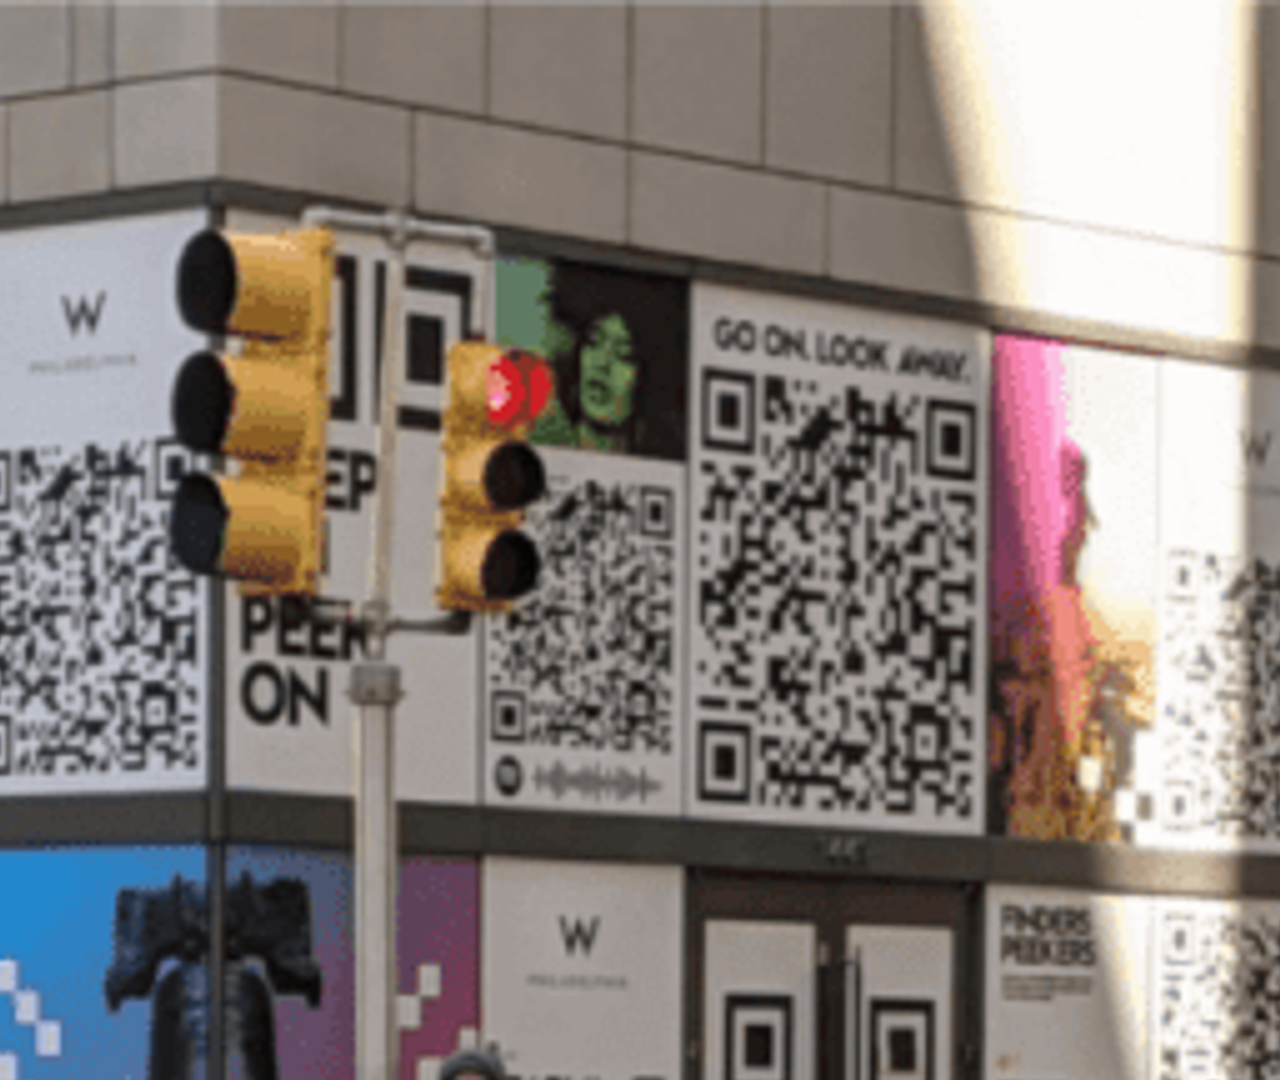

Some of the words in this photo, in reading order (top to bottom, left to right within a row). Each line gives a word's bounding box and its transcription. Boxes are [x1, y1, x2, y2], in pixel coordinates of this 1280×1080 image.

[60, 289, 106, 336] W
[714, 316, 756, 353] GO
[816, 331, 889, 371] LOOK
[240, 659, 330, 728] ON
[557, 914, 601, 960] W
[1001, 904, 1092, 935] FINDERS
